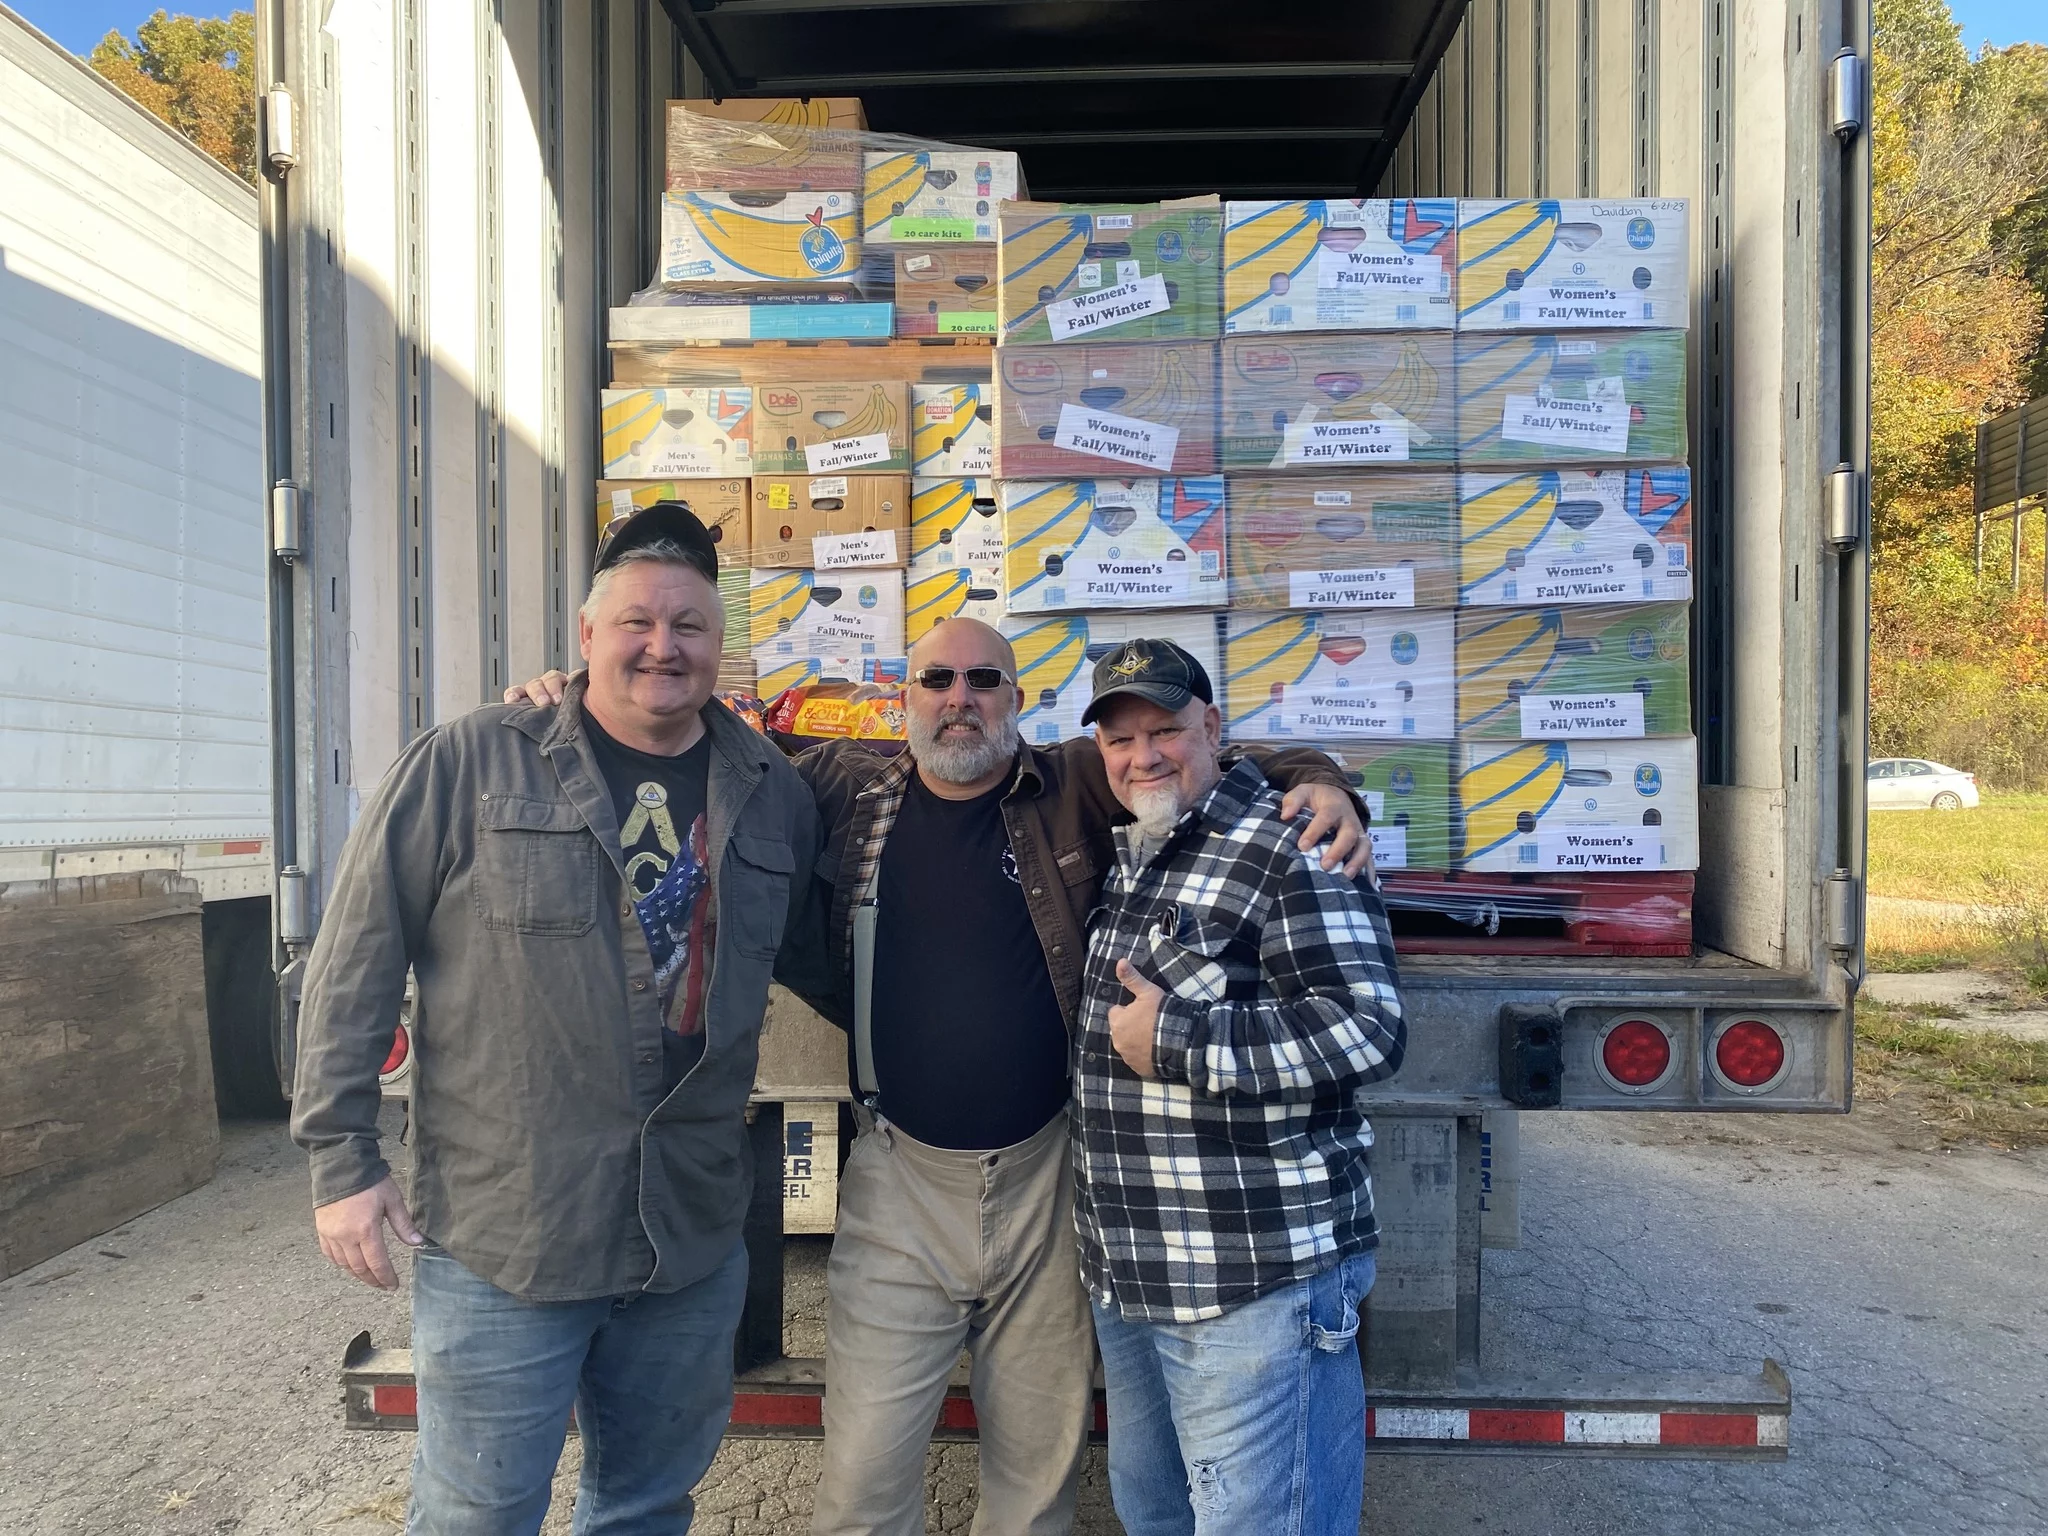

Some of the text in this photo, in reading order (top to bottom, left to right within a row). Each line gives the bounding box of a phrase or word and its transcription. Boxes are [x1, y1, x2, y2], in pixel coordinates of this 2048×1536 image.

[808, 142, 854, 153] BANANAS
[829, 196, 838, 205] W
[903, 230, 916, 238] 20
[941, 229, 962, 238] kits
[808, 244, 842, 270] Chiquita
[1349, 253, 1414, 266] Women's
[672, 267, 710, 278] CLASS EXTRA
[1336, 271, 1424, 286] Fall/Winter
[1073, 283, 1138, 309] Women's
[1549, 288, 1617, 300] Women's
[1067, 299, 1152, 331] Fall/Winter
[1538, 307, 1627, 320] Fall/Winter
[768, 393, 798, 405] Dole
[1535, 397, 1603, 413] Women's
[927, 406, 952, 414] DONATION
[1086, 419, 1151, 442] Women's
[1313, 424, 1381, 437] Women's
[1522, 414, 1612, 434] Fall/Winter
[832, 439, 861, 451] Men's
[1072, 435, 1157, 463] Fall/Winter
[1303, 443, 1392, 458] Fall/Winter
[667, 451, 696, 460] Men's
[819, 451, 879, 467] Fall/Winter
[652, 464, 711, 474] Fall/Winter
[840, 540, 869, 551] Men's
[826, 551, 886, 565] Fall/Winter
[1098, 563, 1163, 575] Women's
[1545, 563, 1614, 578] Women's
[1318, 570, 1386, 583] Women's
[1087, 582, 1173, 595] Fall/Winter
[1536, 581, 1626, 598] Fall/Winter
[1308, 589, 1397, 604] Fall/Winter
[833, 613, 862, 625] Men's
[816, 626, 875, 641] Fall/Winter
[1311, 695, 1377, 709] Women's
[1549, 697, 1617, 711] Women's
[804, 707, 817, 720] &
[1299, 714, 1387, 728] Fall/Winter
[1539, 716, 1628, 731] Fall/Winter
[1635, 780, 1661, 790] Chiquita
[1566, 835, 1634, 848] Women's
[1556, 853, 1644, 867] Fall/Winter
